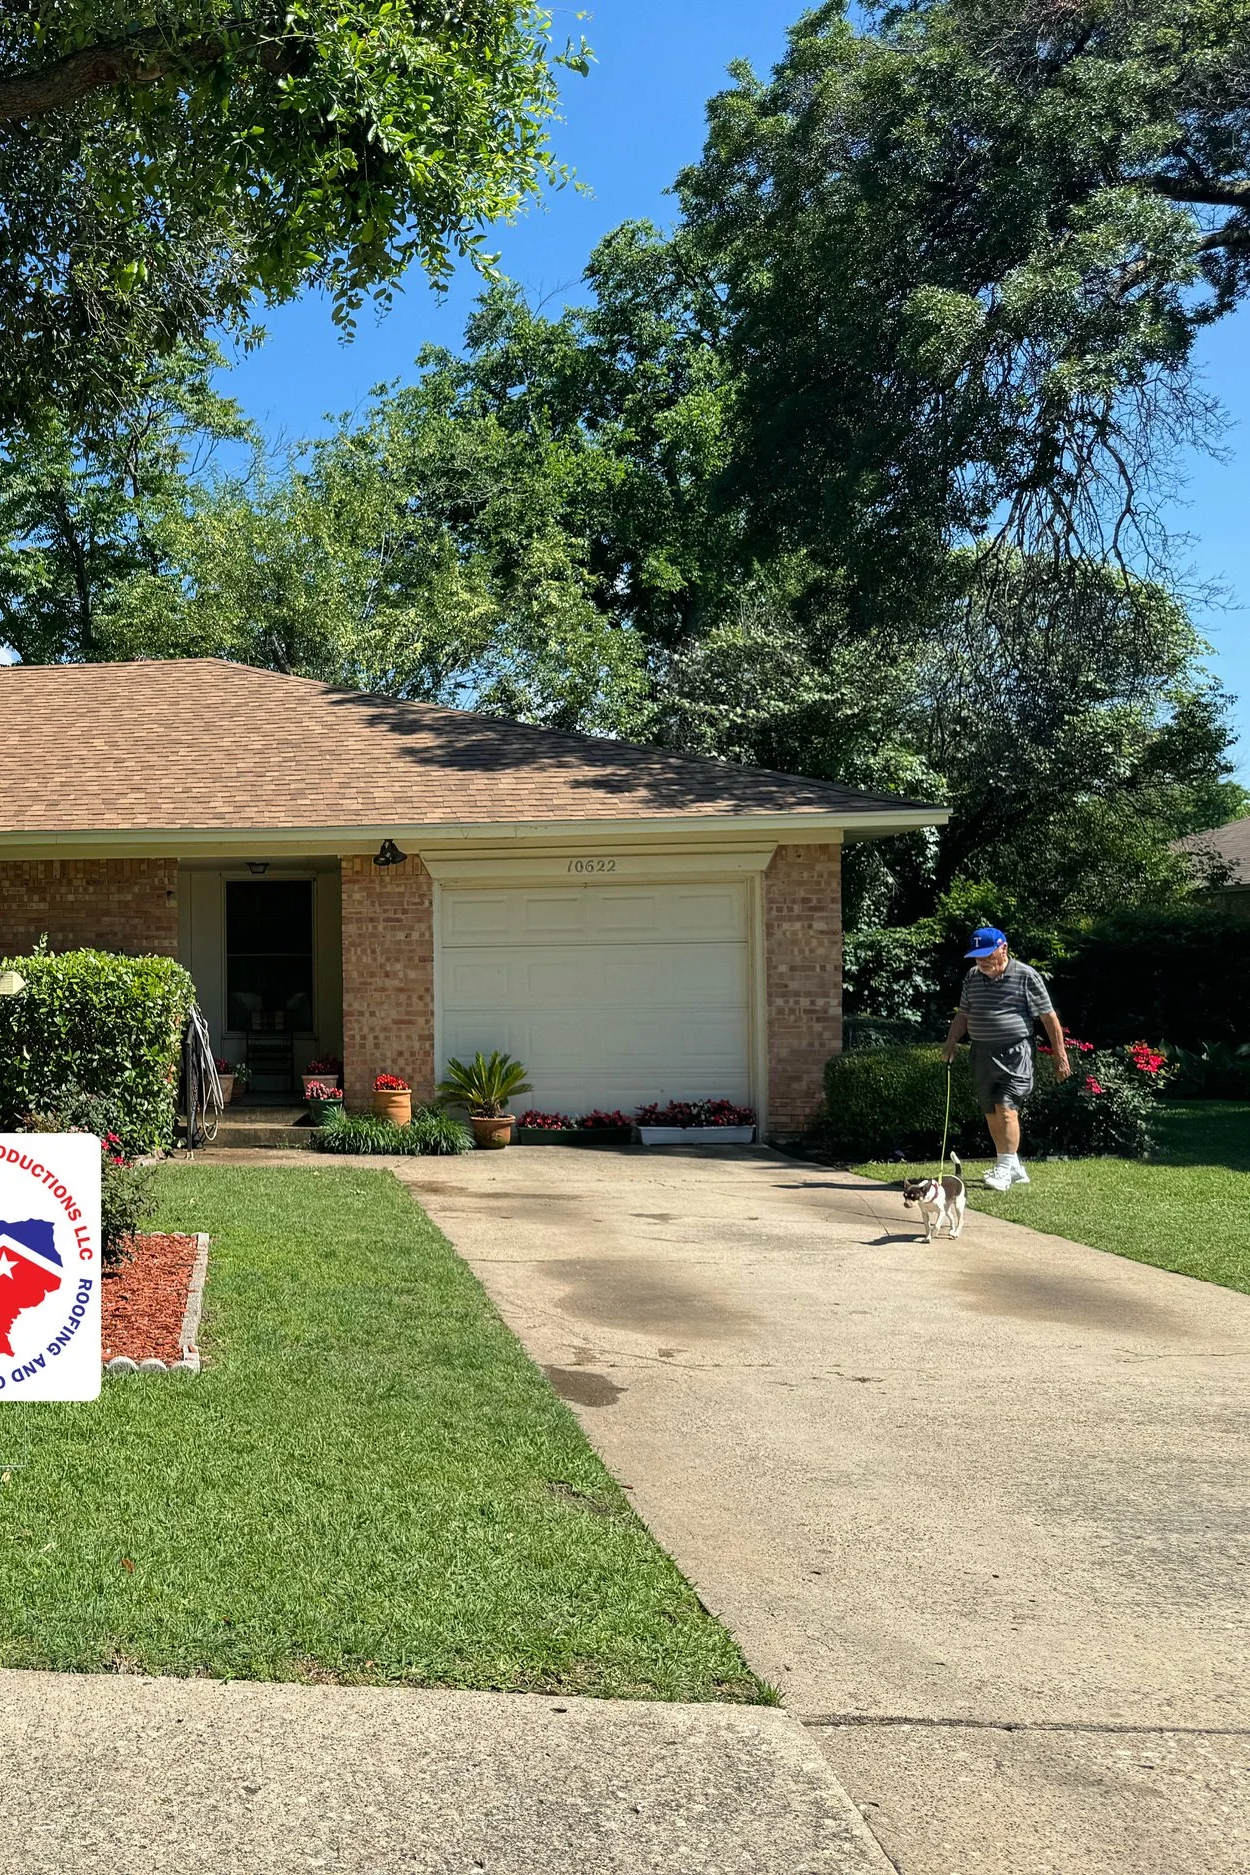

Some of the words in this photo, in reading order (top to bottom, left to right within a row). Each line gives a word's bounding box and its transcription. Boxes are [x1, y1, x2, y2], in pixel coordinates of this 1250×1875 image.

[567, 859, 616, 873] 10622
[973, 936, 982, 948] T
[73, 1225, 94, 1261] LLC
[45, 1278, 93, 1356] ROOFING
[11, 1353, 47, 1383] AND
